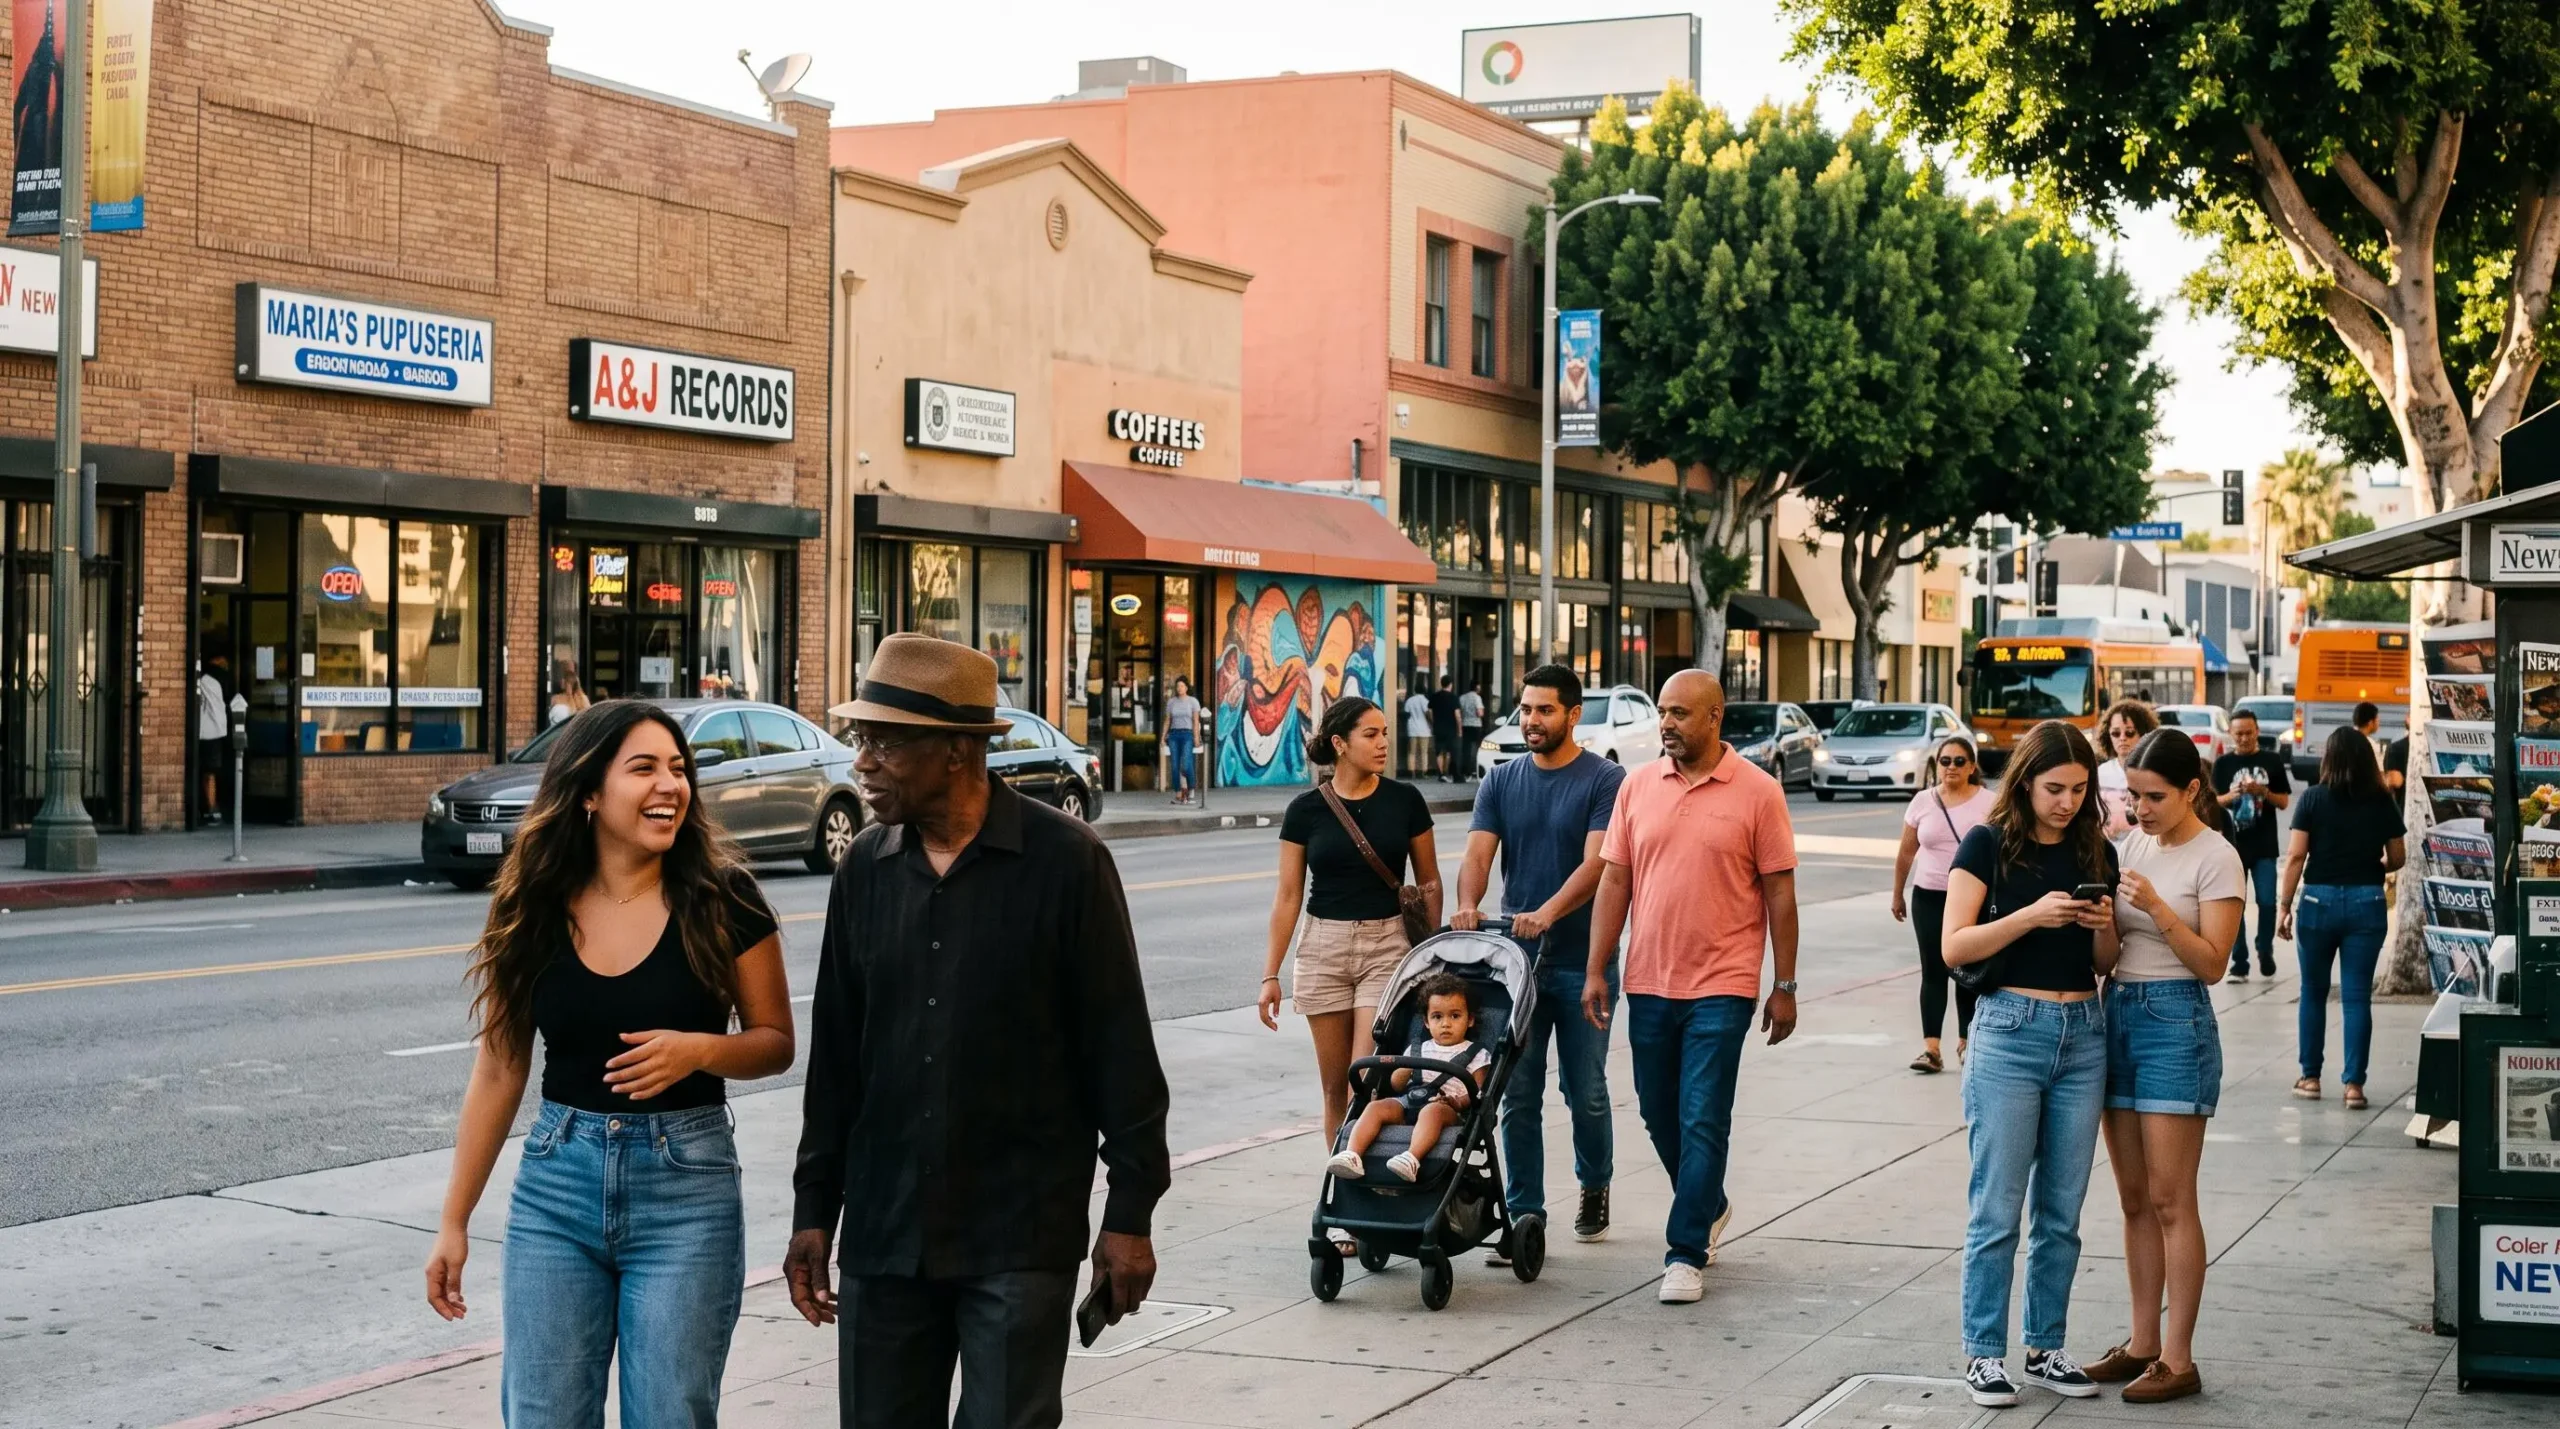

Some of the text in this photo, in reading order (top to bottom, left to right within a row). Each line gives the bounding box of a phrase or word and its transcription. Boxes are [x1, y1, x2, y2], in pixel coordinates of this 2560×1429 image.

[22, 288, 57, 316] NEW
[268, 299, 484, 364] MARIA'S PUPUSERIA
[593, 354, 788, 430] A&J RECORDS
[1114, 408, 1206, 451] COFFEES
[1137, 446, 1185, 468] COFFEE
[2500, 539, 2560, 569] New
[321, 571, 363, 596] OPEN
[2496, 1235, 2549, 1255] Coler
